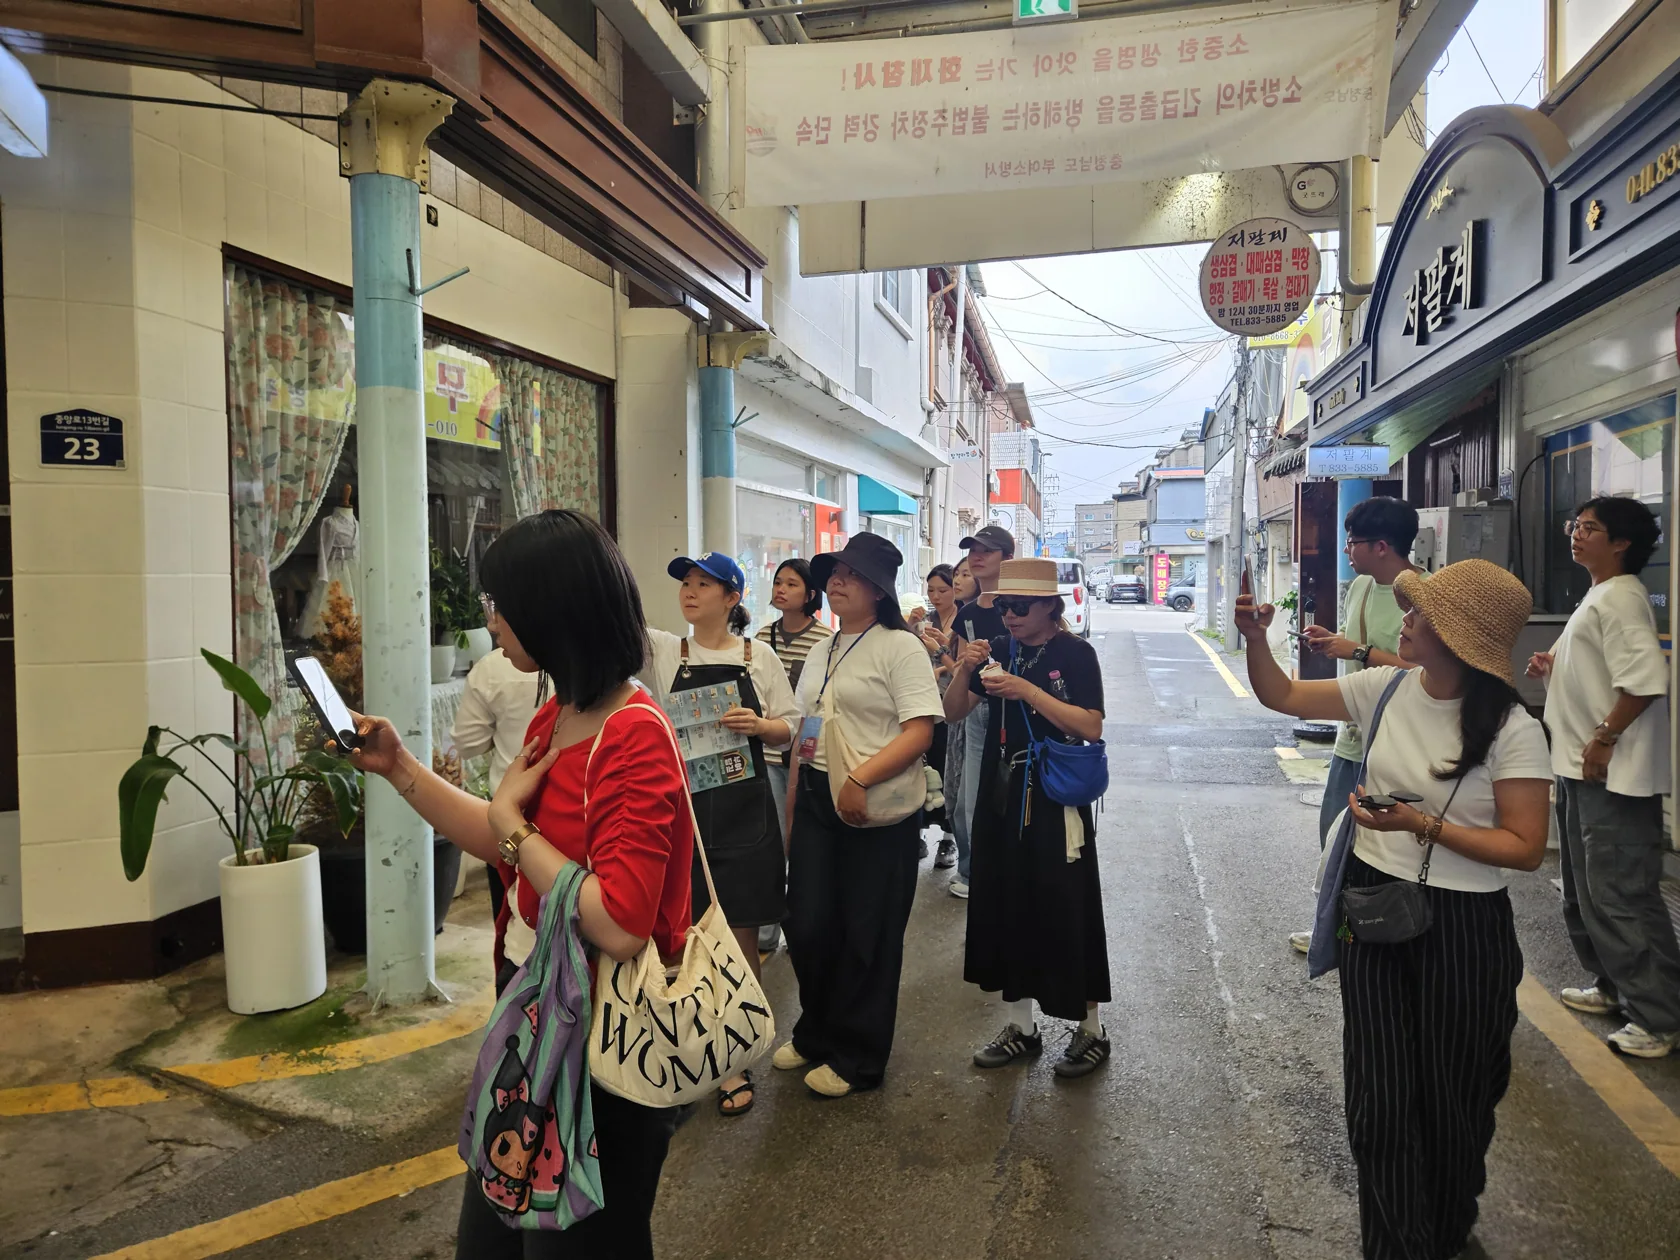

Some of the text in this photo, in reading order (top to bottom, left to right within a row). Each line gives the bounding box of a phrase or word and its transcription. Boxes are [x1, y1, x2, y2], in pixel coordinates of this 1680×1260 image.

[1228, 227, 1287, 247] 저팔계
[1210, 247, 1310, 279] 생삼겹 대패삼겹 막창
[1209, 281, 1225, 306] 항정
[1232, 279, 1255, 304] 갈매기
[1263, 276, 1279, 301] 목살
[1401, 219, 1474, 346] 저팔계
[1218, 301, 1299, 319] 밤 12시 30분까지 영업
[54, 414, 110, 426] 중앙로13번길
[64, 437, 100, 460] 23
[601, 1001, 771, 1094] WOMAN
